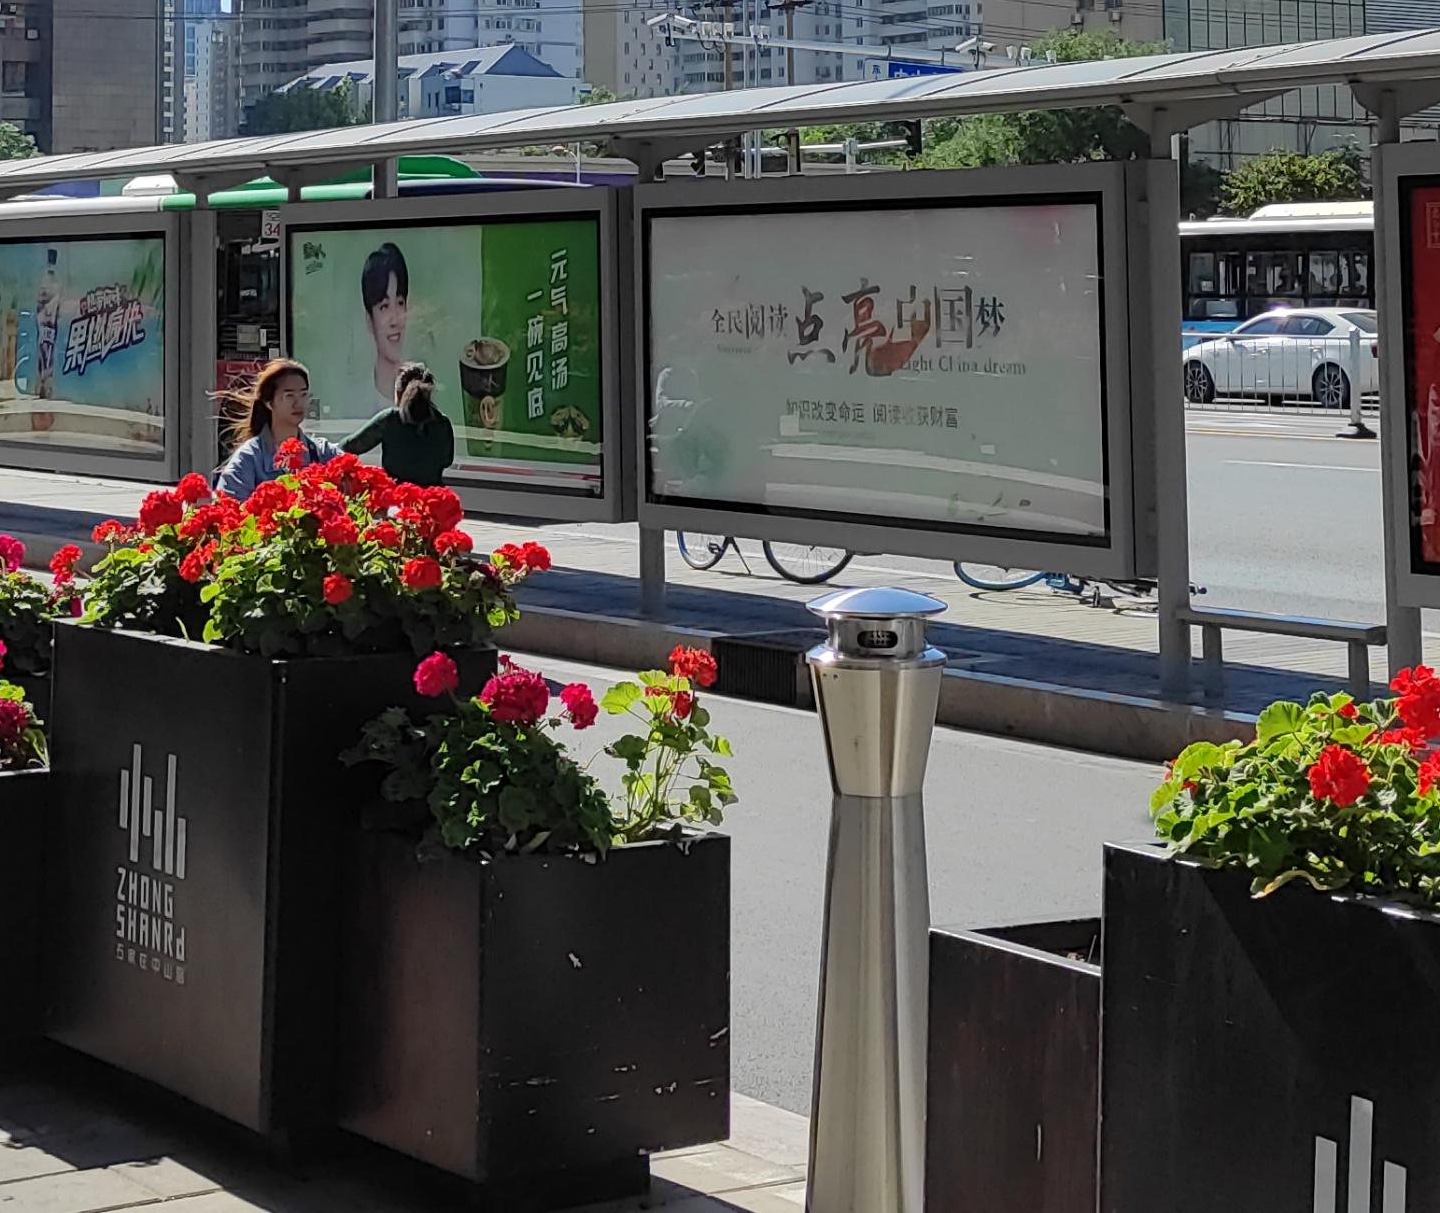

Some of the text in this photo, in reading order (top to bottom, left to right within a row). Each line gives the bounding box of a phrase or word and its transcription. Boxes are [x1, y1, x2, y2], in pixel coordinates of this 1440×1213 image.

[549, 248, 569, 391] 元气高汤
[526, 290, 545, 420] 一碗见底
[984, 357, 1026, 375] dream
[786, 398, 959, 429] 知识改变命运 阅读收获财富
[117, 867, 174, 919] ZHONG
